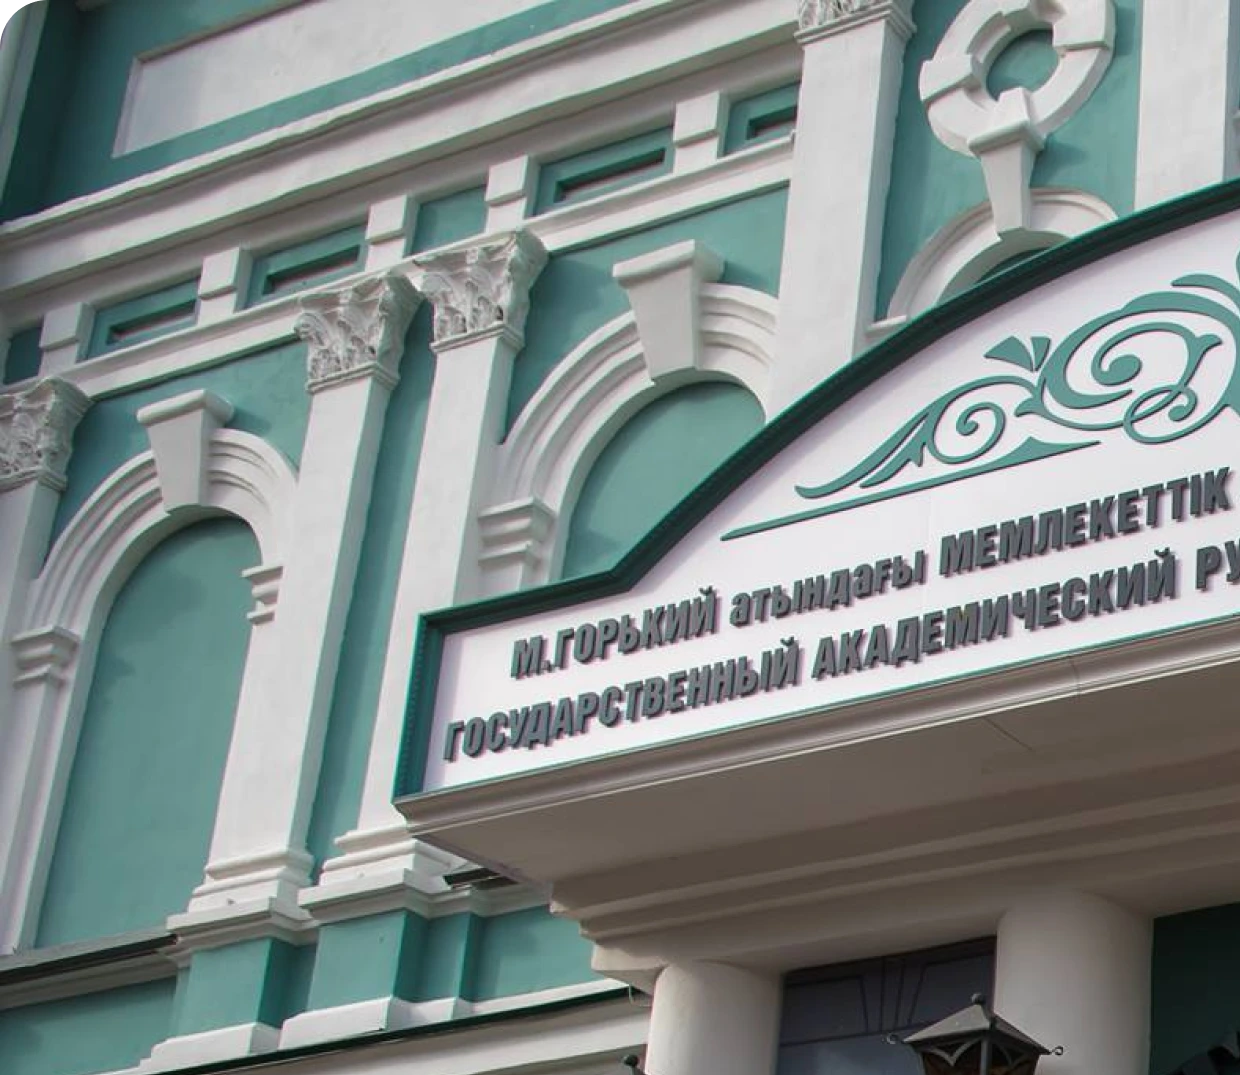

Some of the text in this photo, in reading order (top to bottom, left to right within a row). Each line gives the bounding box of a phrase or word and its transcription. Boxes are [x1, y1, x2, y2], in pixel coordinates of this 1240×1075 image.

[443, 636, 801, 763] ГОСУДАРСТВЕННЫЙ
[811, 548, 1178, 680] АКАДЕМИЧЕСКИЙ
[510, 587, 719, 679] М.ГОРЬКИЙ
[728, 550, 926, 628] атындағы
[939, 467, 1231, 578] МЕМЛЕКЕТТІК
